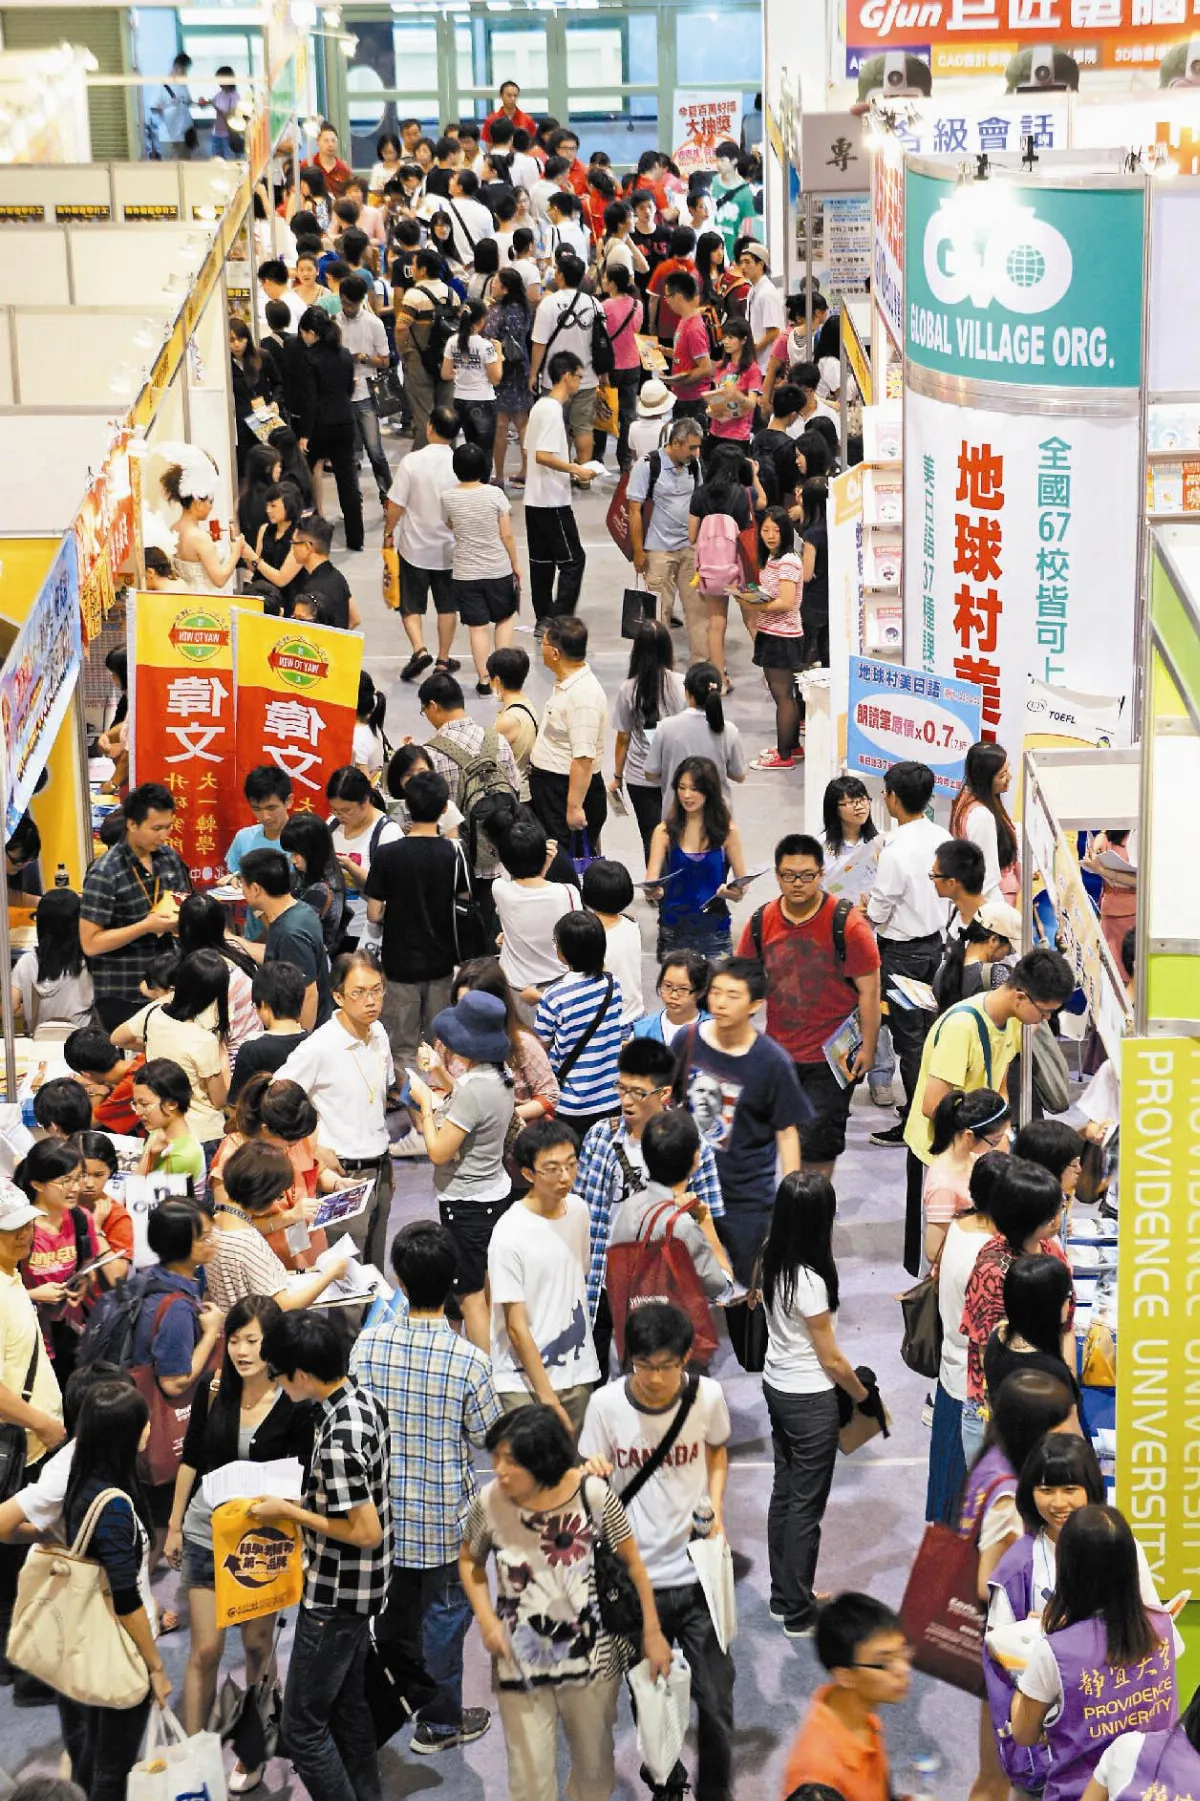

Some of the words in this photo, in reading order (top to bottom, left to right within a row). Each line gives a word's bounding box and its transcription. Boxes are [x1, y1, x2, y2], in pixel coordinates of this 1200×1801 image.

[860, 0, 942, 37] Gjun
[947, 0, 1200, 30] 巨匠電腦
[825, 137, 858, 172] 專
[910, 303, 952, 356] GLOBAL
[956, 317, 1045, 366] VILLAGE
[1052, 325, 1115, 369] ORG.
[922, 453, 935, 672] 美日語37種課
[953, 440, 1004, 743] 地球村美
[858, 662, 942, 699] 地球村美日語
[1049, 710, 1077, 725] TOEFL
[1133, 1050, 1174, 1318] PROVIDENCE
[1131, 1339, 1169, 1585] UNIVERSITY
[1084, 1676, 1172, 1720] PROVIDENCE
[1089, 1697, 1172, 1739] UNIVERSITY
